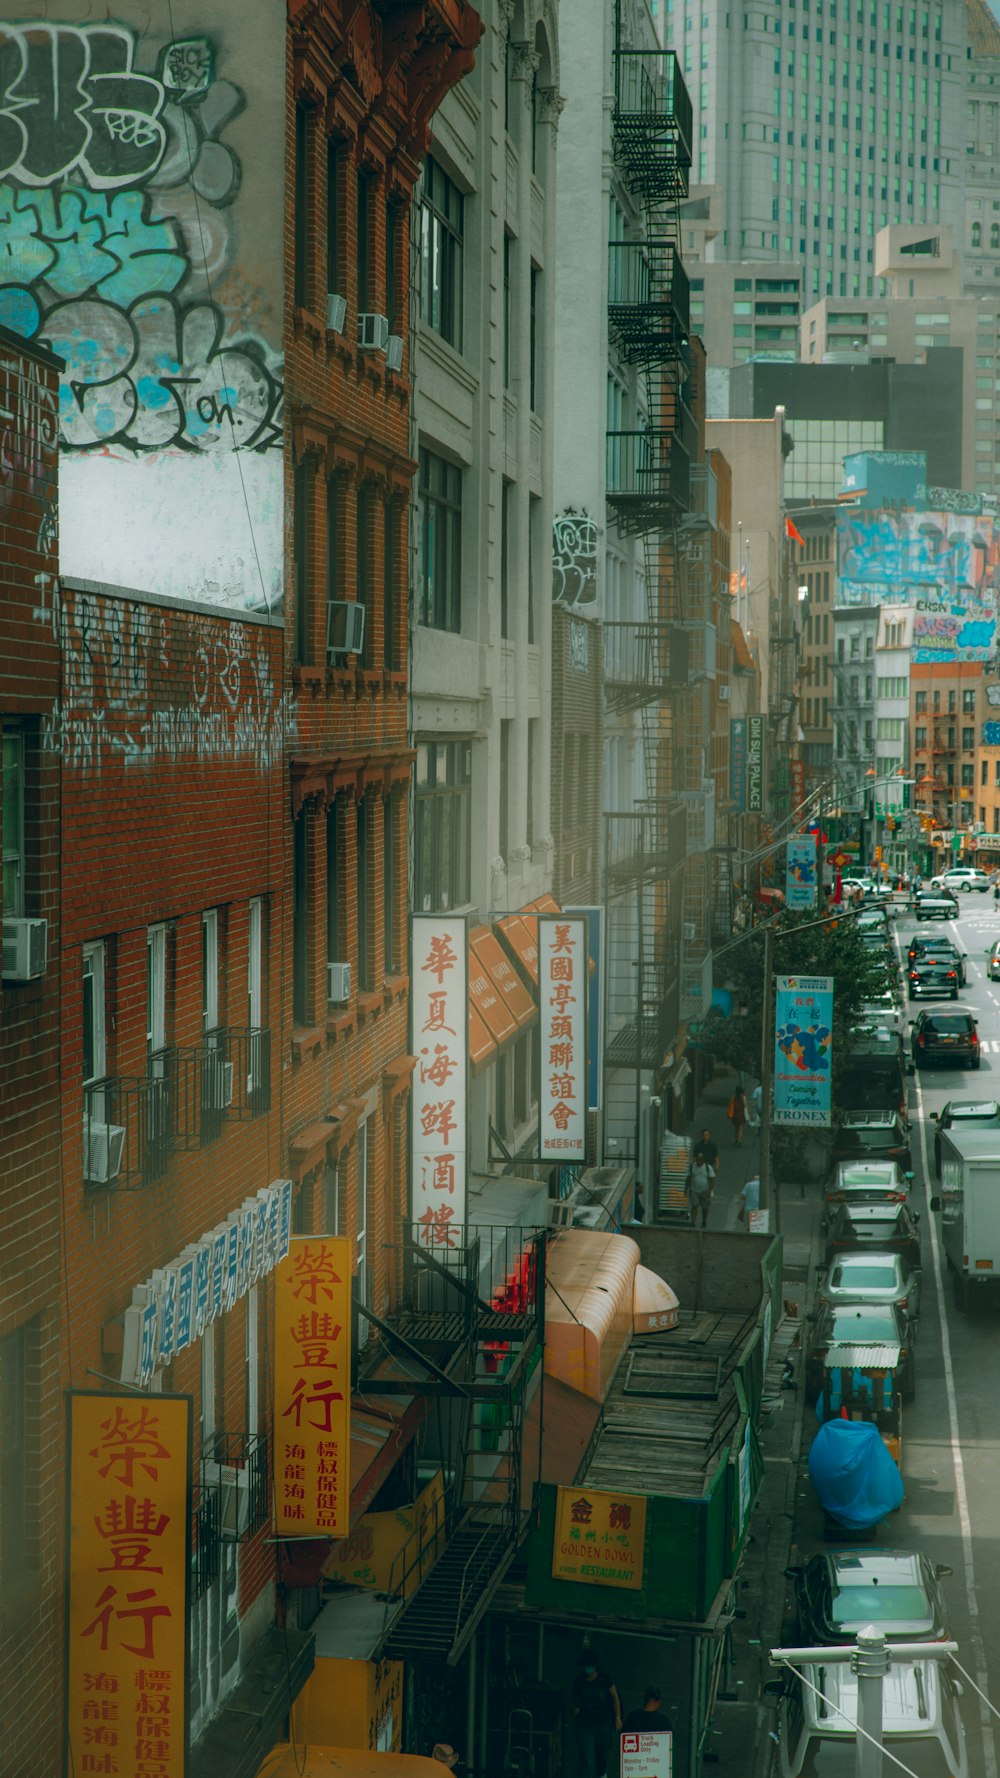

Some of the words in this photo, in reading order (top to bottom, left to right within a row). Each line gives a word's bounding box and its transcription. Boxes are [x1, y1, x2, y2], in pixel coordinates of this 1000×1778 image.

[750, 717, 761, 738] DIM
[750, 740, 761, 763] SUM
[750, 765, 761, 809] PALACE
[548, 924, 577, 1131] 美國亭頭聯誼會
[417, 933, 460, 1248] 華夏海鮮酒樓
[786, 1096, 822, 1107] Together
[788, 1084, 818, 1095] Coming
[776, 1110, 828, 1122] TRONEX
[282, 1244, 344, 1433] 榮豐行
[283, 1444, 306, 1520] 海龍海味
[316, 1441, 338, 1527] 標叔保健品
[80, 1406, 172, 1660] 榮豐行
[561, 1542, 601, 1559] GOLDEN
[605, 1549, 636, 1564] BOWL
[579, 1564, 635, 1581] RESTAURANT
[81, 1672, 120, 1774] 海龍海味
